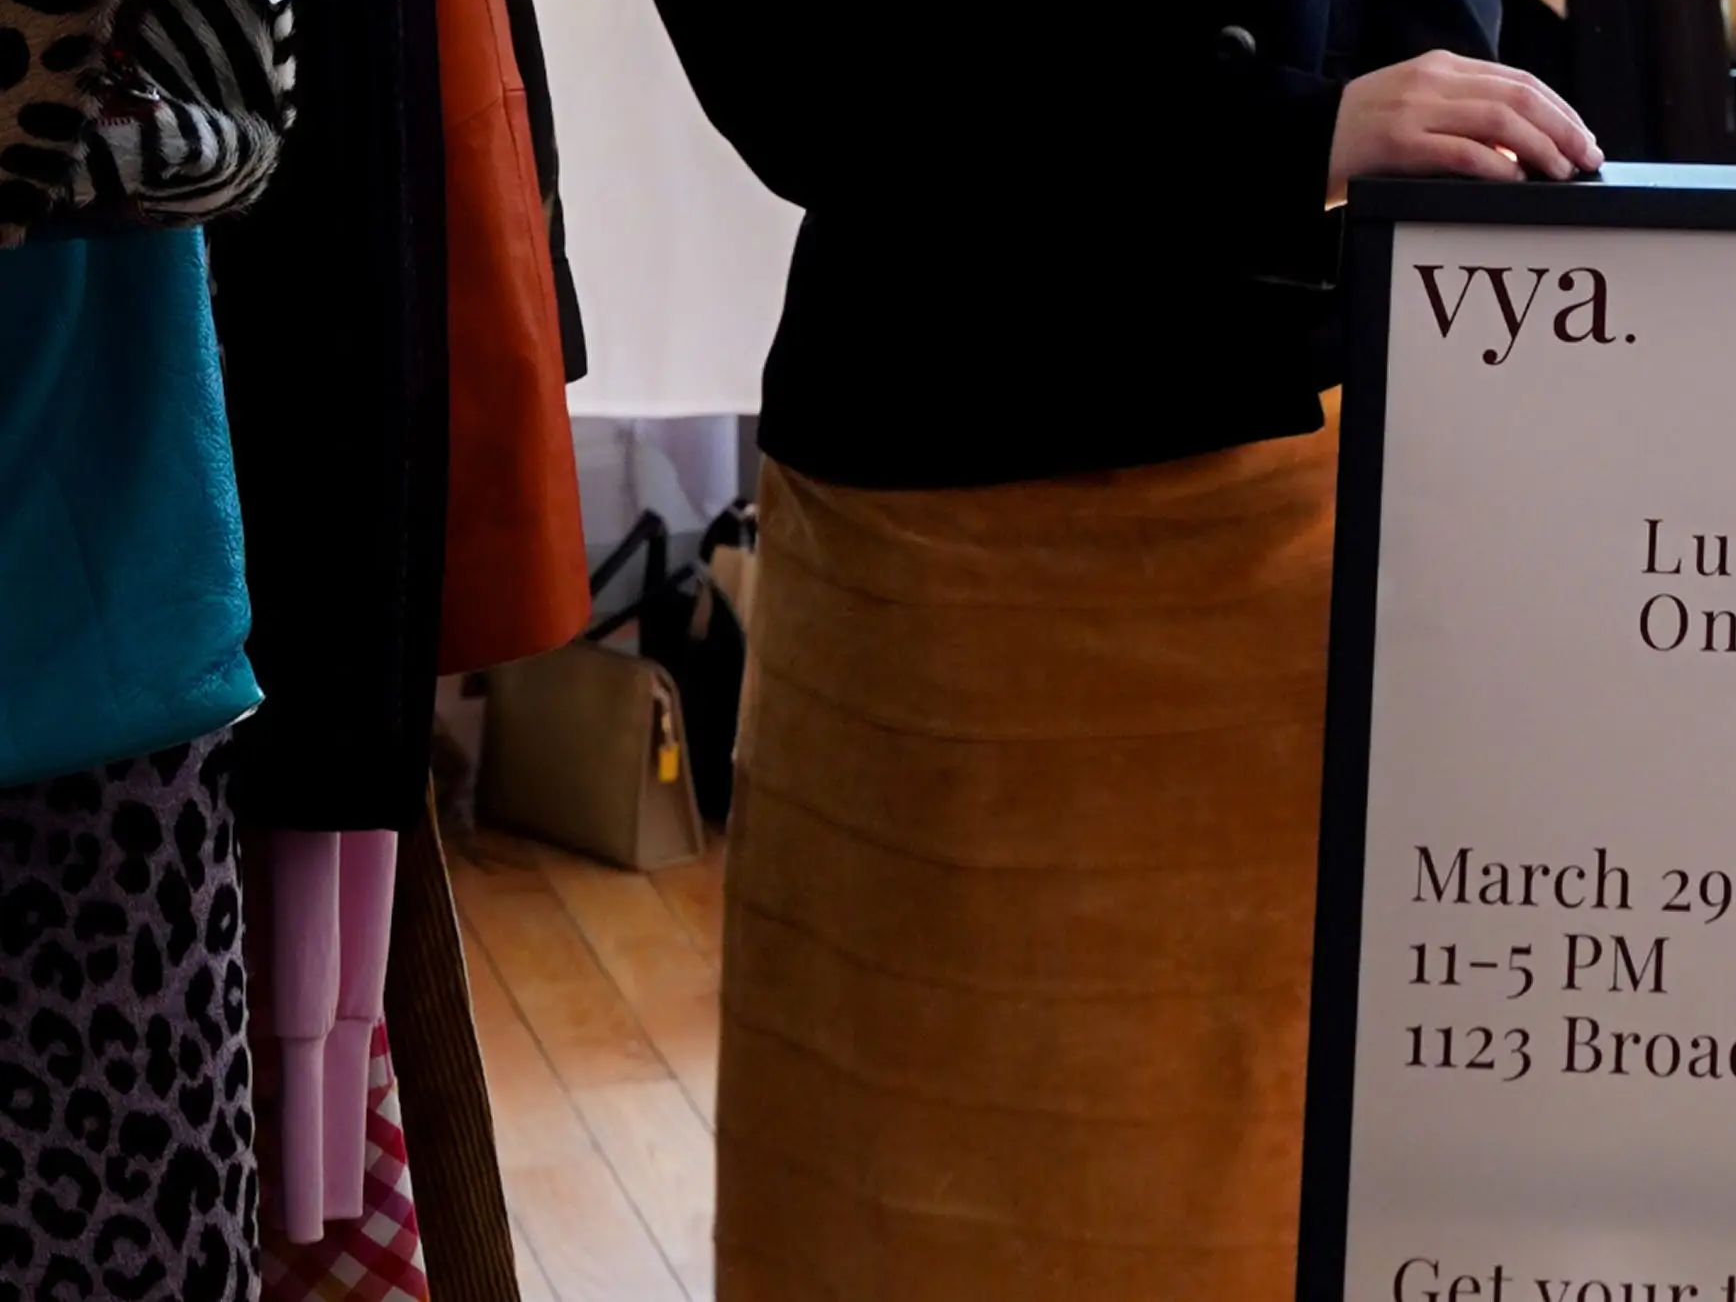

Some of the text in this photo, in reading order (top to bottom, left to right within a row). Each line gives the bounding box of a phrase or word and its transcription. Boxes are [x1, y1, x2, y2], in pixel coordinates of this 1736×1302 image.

[1414, 264, 1637, 367] vya.
[1411, 844, 1633, 912] March
[1561, 932, 1670, 995] PM
[1405, 1023, 1533, 1083] 1123
[1393, 1258, 1514, 1302] Get
